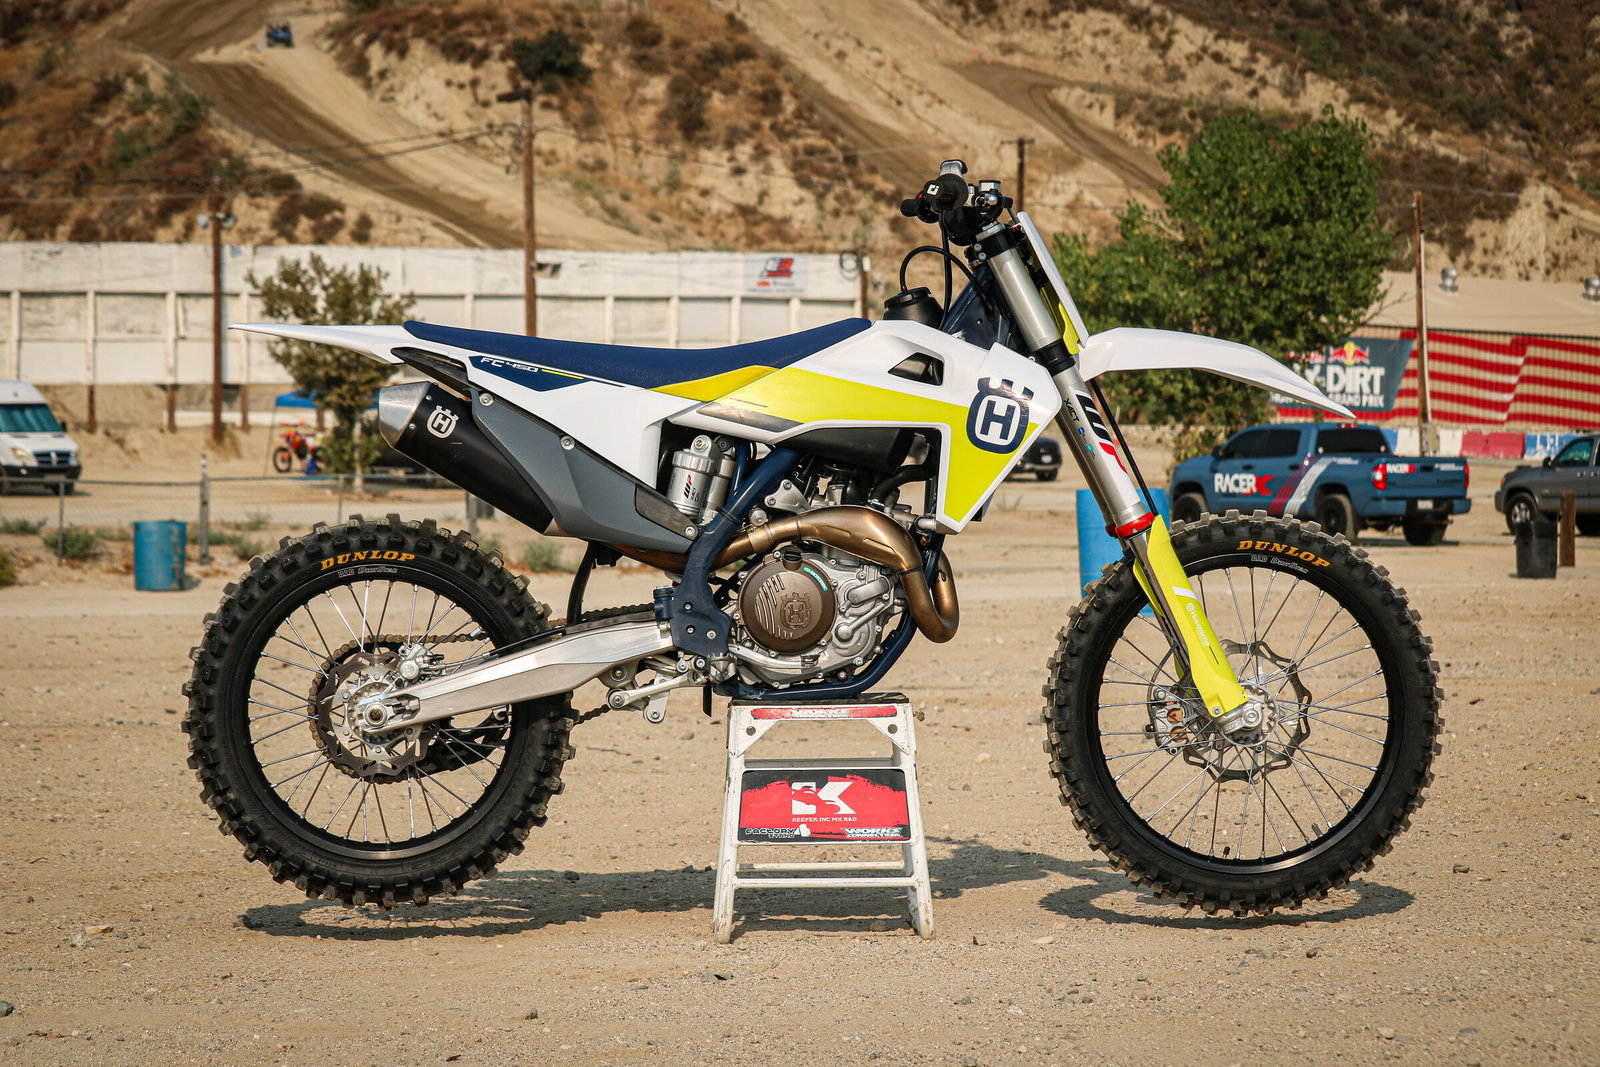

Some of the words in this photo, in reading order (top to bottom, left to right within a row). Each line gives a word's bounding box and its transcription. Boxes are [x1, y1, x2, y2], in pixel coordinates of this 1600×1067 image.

[1064, 398, 1080, 422] XACT
[320, 550, 416, 571] DUNLOP
[1237, 540, 1331, 568] DUNLOP
